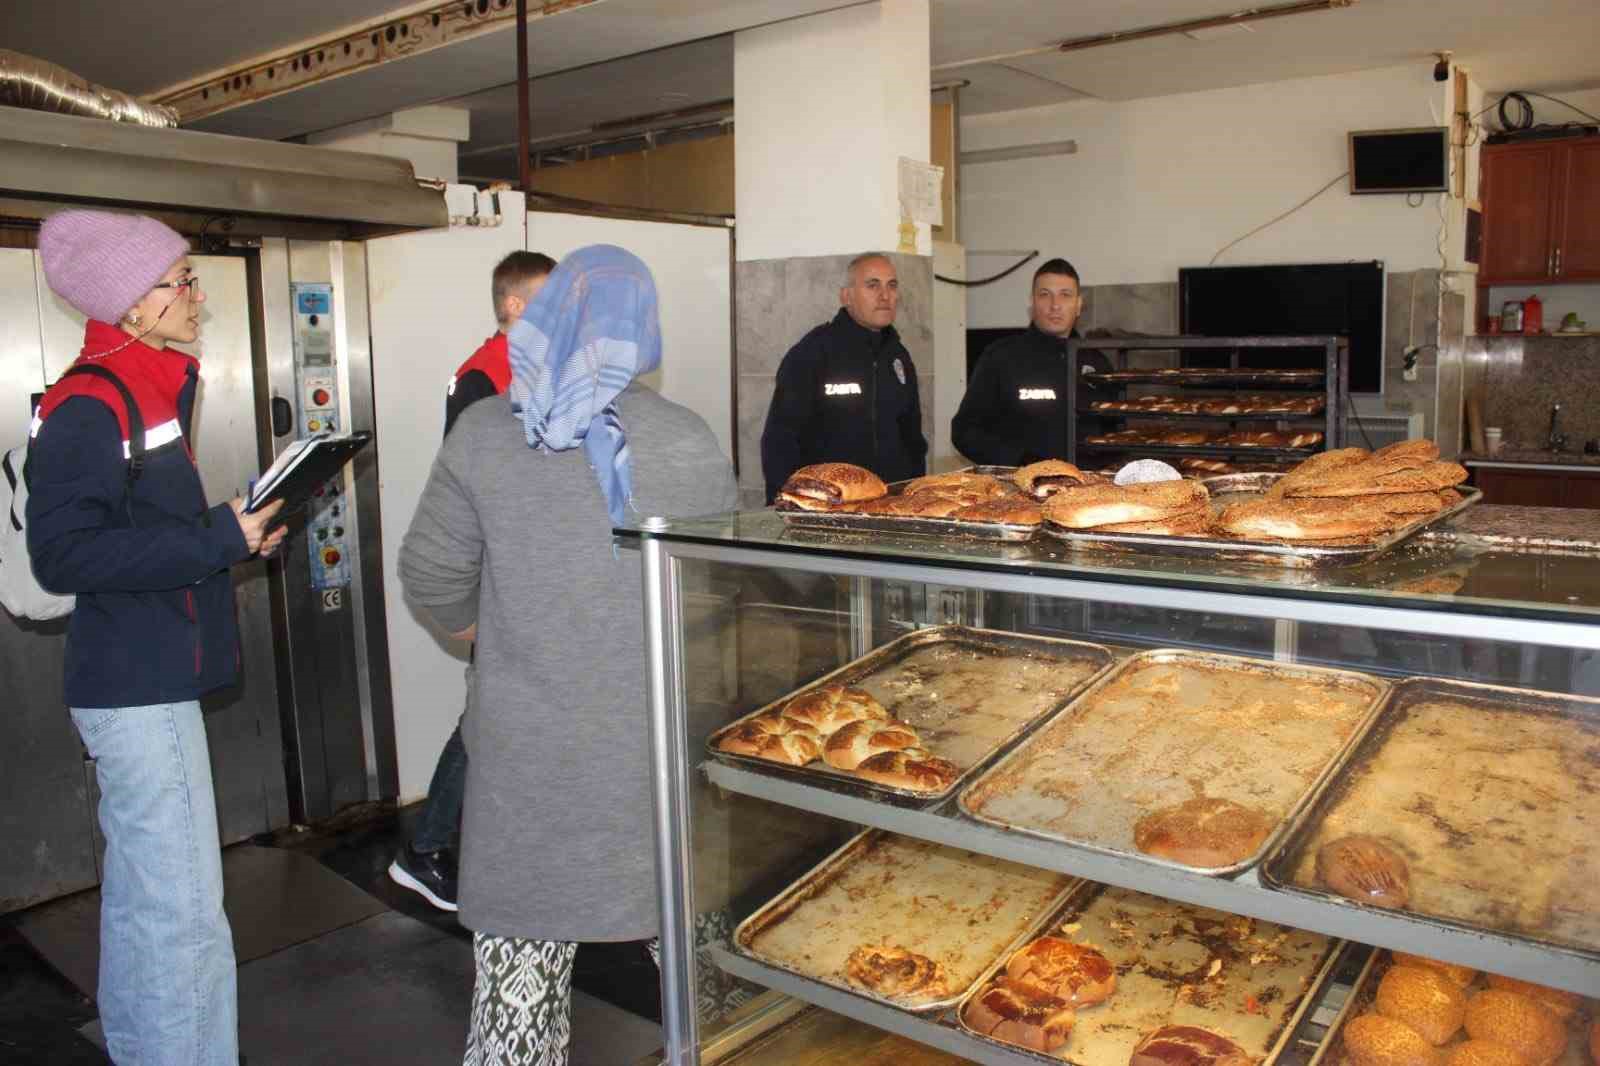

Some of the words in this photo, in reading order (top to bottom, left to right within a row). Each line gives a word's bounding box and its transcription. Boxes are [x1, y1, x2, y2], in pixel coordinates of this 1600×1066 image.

[824, 383, 862, 395] ZABITA
[1018, 388, 1057, 400] ZABITA
[324, 591, 340, 607] CE
